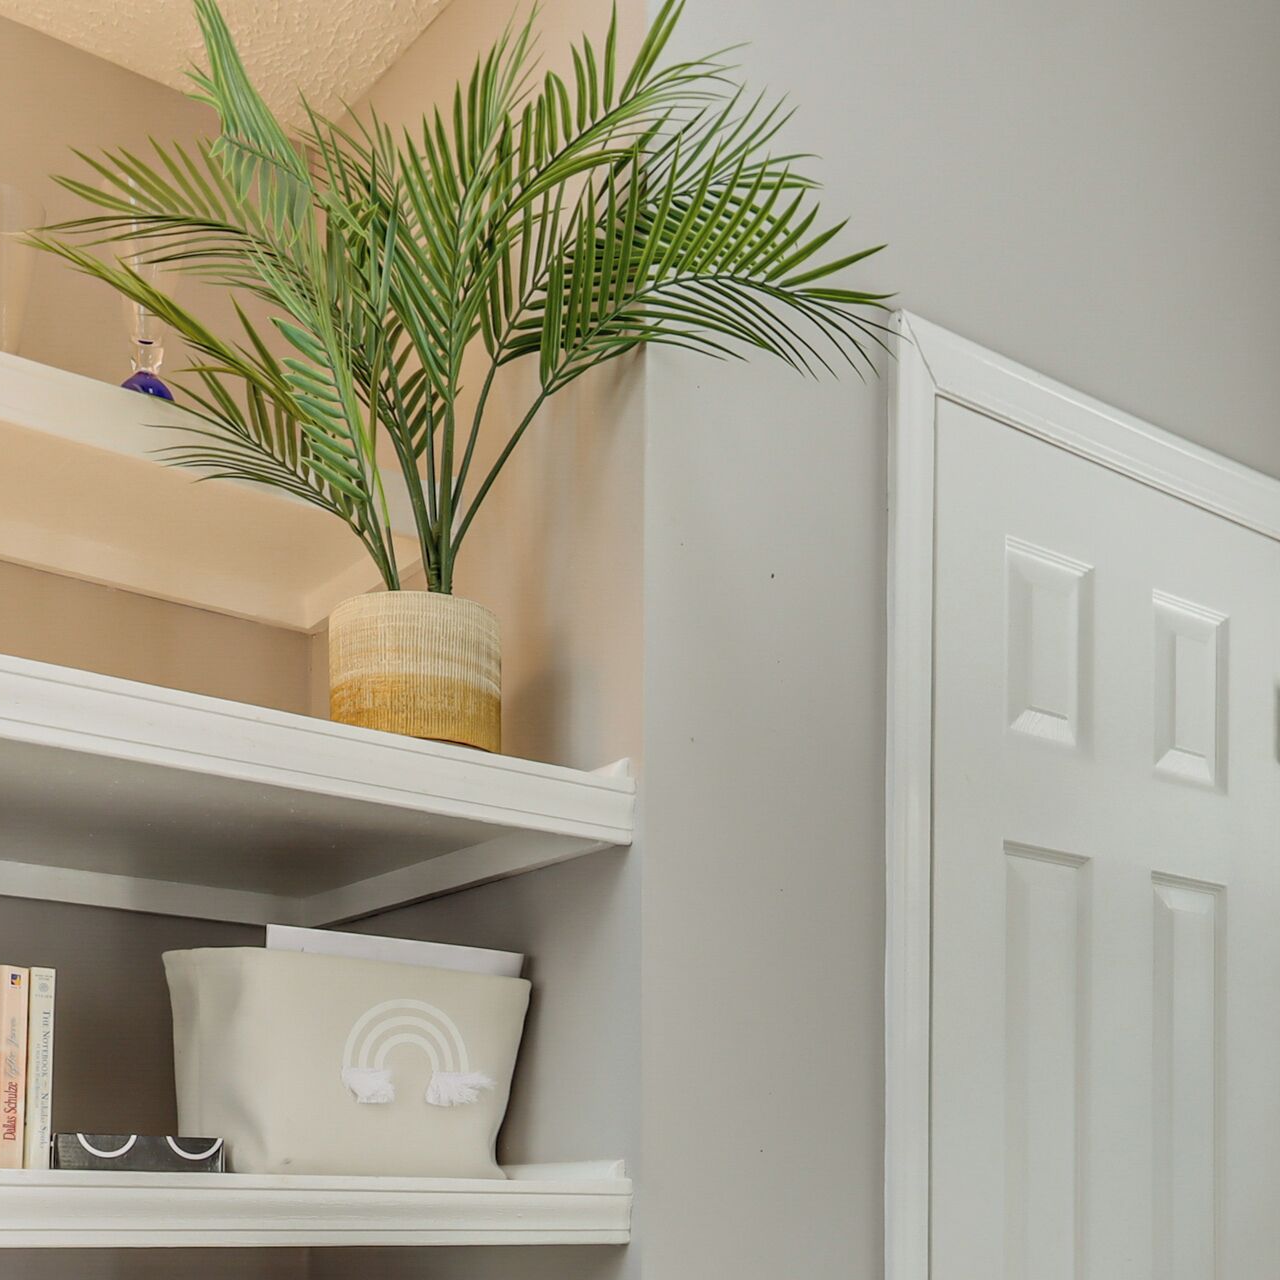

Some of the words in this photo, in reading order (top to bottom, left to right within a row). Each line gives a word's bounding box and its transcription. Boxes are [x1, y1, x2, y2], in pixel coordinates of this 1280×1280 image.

[42, 1010, 51, 1026] THE
[41, 1031, 50, 1077] NOTEBOOK
[3, 1081, 18, 1114] Schulze
[2, 1116, 17, 1141] Dallas
